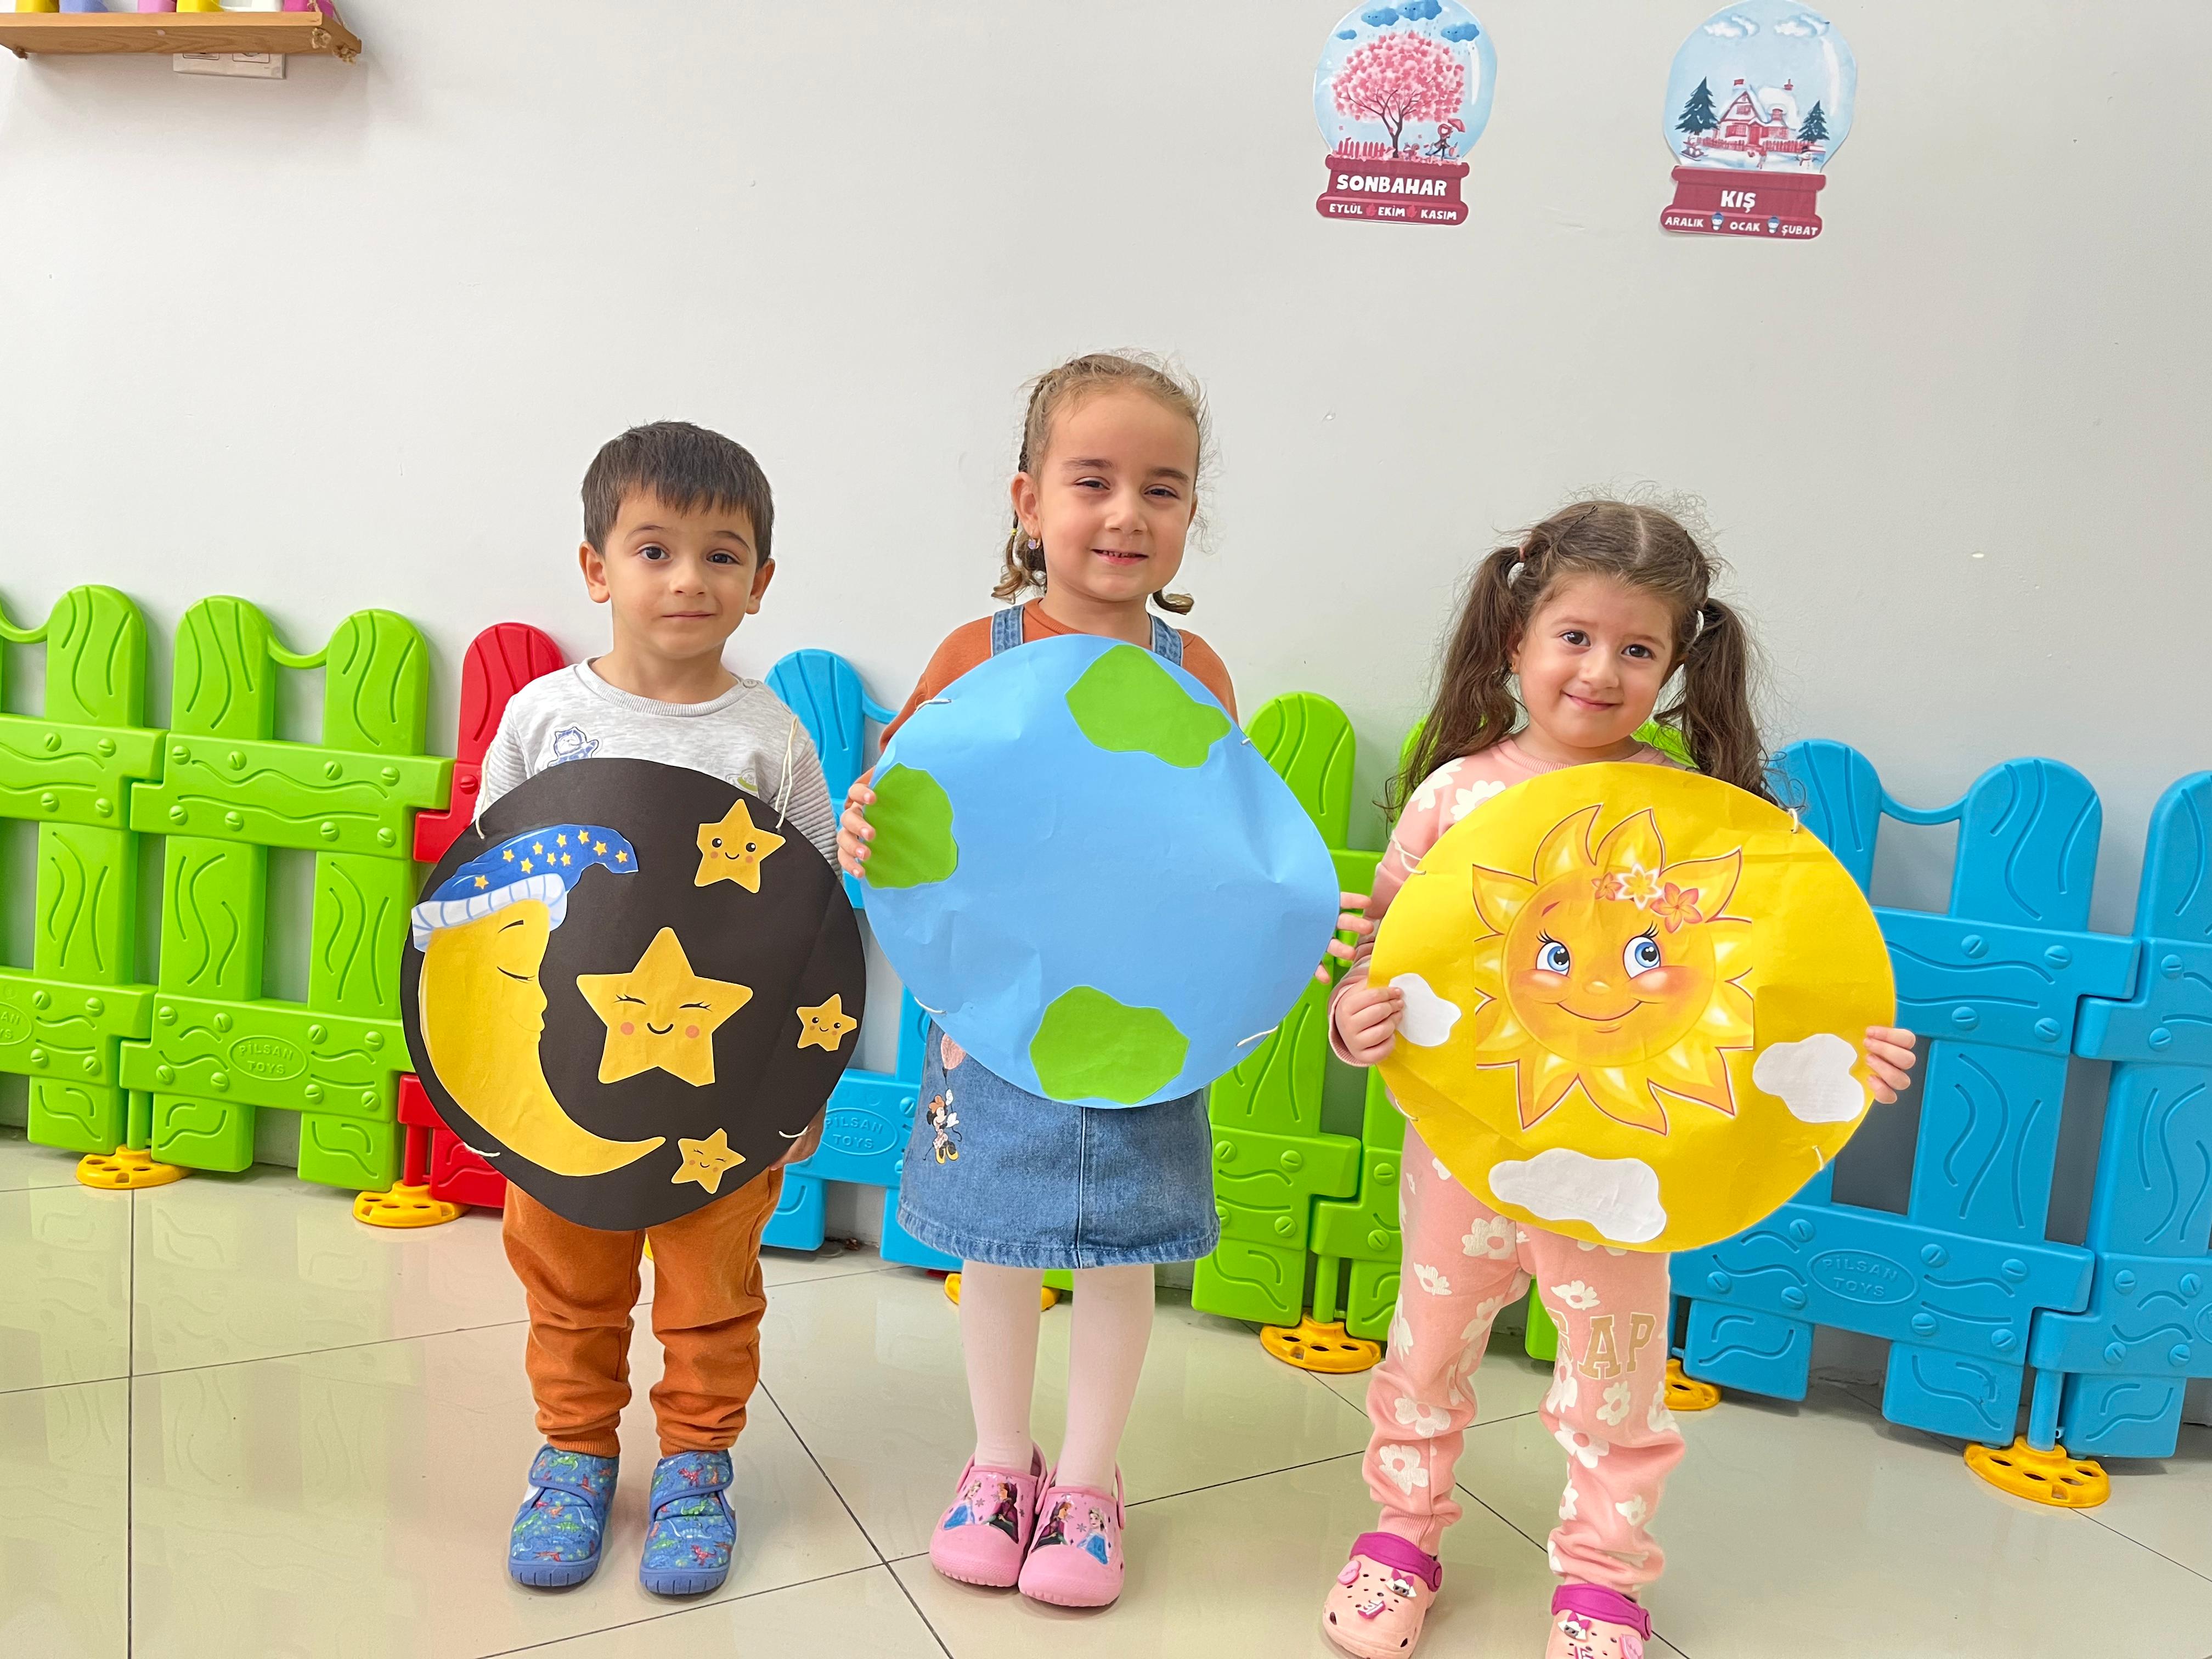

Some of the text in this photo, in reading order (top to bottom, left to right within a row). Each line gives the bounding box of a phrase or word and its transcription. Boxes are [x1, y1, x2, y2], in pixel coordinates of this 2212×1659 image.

[1336, 174, 1447, 196] SONBAHAR
[1329, 203, 1457, 220] EYLÜL EKİM KASIM
[1720, 190, 1756, 213] KIŞ
[1664, 216, 1818, 236] ARALIK OCAK ŞUBAT
[247, 1060, 285, 1074] TOYS
[833, 1134, 873, 1149] TOYS
[1833, 1277, 1884, 1297] TOYS
